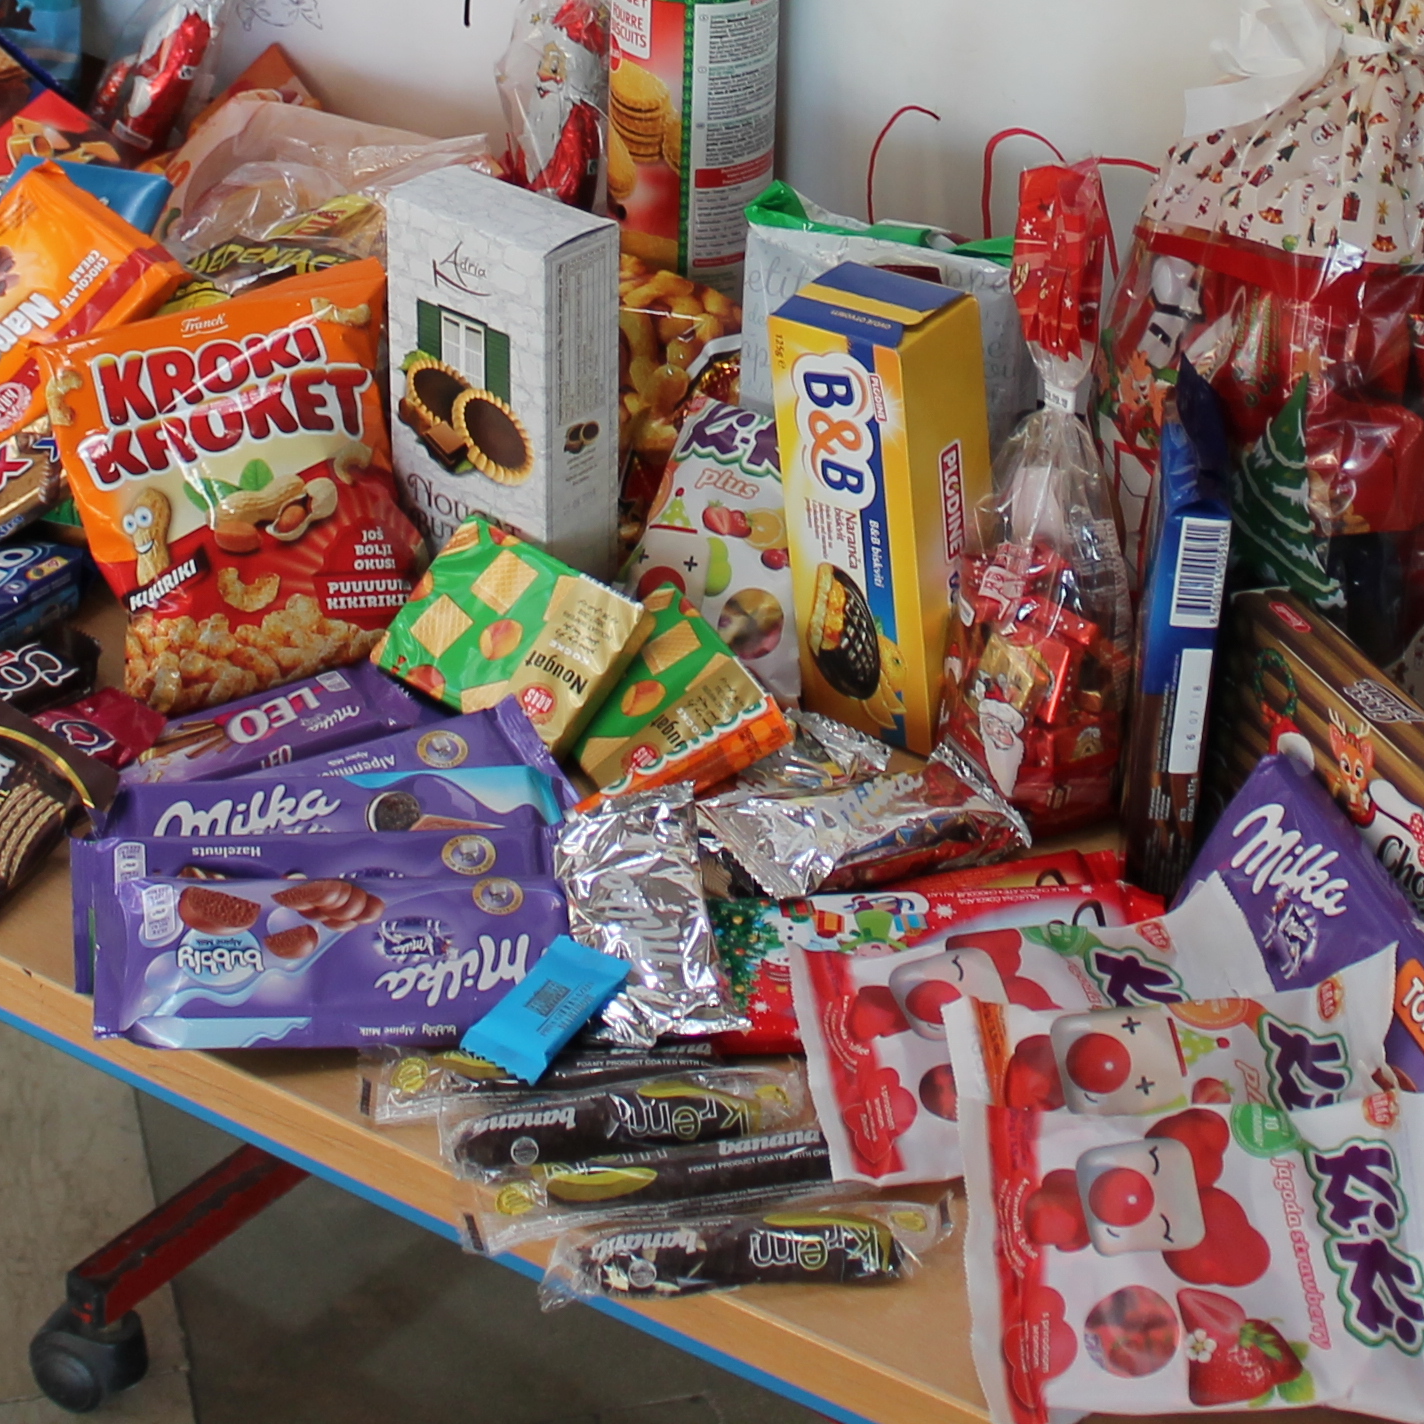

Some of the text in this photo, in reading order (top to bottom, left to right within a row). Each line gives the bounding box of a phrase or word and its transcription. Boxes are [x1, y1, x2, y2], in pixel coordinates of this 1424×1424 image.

[59, 255, 110, 311] CHOCOLATE
[68, 249, 100, 284] CREAM
[181, 312, 228, 336] Franck
[91, 324, 327, 428] KROKI
[78, 366, 370, 491] KROKET
[803, 371, 866, 495] B&B
[695, 468, 760, 500] plus
[353, 544, 393, 557] BOLJI
[361, 526, 385, 544] JOŠ
[844, 510, 860, 570] Naranča
[128, 558, 199, 612] KIKIRIKI
[353, 558, 396, 572] OKUS!
[525, 649, 588, 696] Nougat
[226, 686, 322, 744] LEO
[152, 783, 342, 837] Milka
[191, 845, 263, 859] Hazelnuts
[1231, 803, 1349, 918] Milka
[176, 942, 266, 974] bubbly
[375, 933, 549, 1008] Milka
[359, 1022, 458, 1038] bubbly Alpine Milk
[605, 1059, 644, 1067] PRODUCT
[717, 1127, 821, 1157] banana
[688, 1163, 717, 1175] FOAMY
[718, 1158, 755, 1172] PRODUCT
[1270, 1157, 1332, 1350] jagoda strawberry
